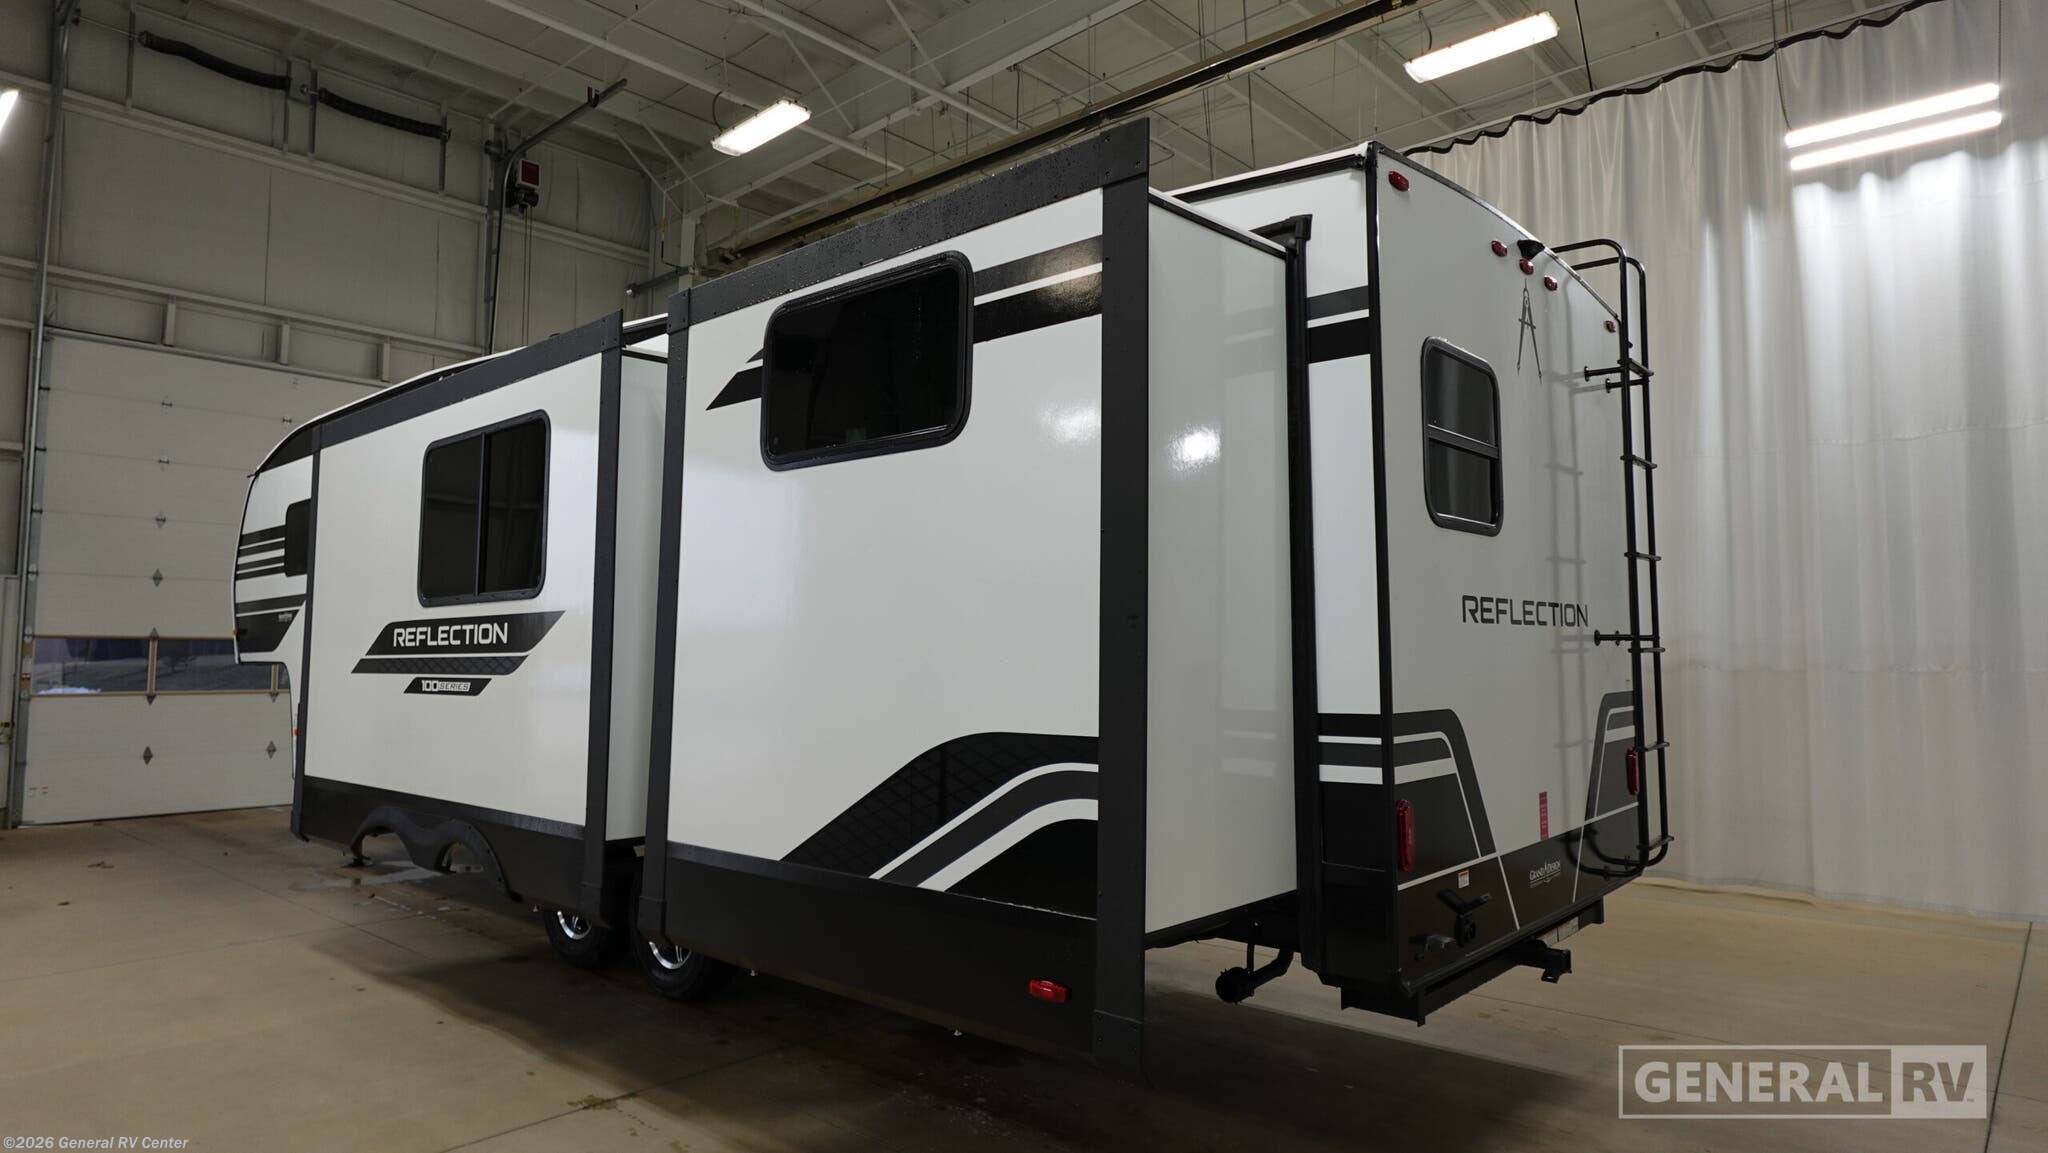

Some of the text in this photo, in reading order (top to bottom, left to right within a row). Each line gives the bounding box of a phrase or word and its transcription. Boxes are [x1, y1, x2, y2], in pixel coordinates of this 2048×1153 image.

[1462, 595, 1588, 627] REFLECTION
[393, 622, 508, 647] REFLECTION
[421, 680, 439, 692] 100
